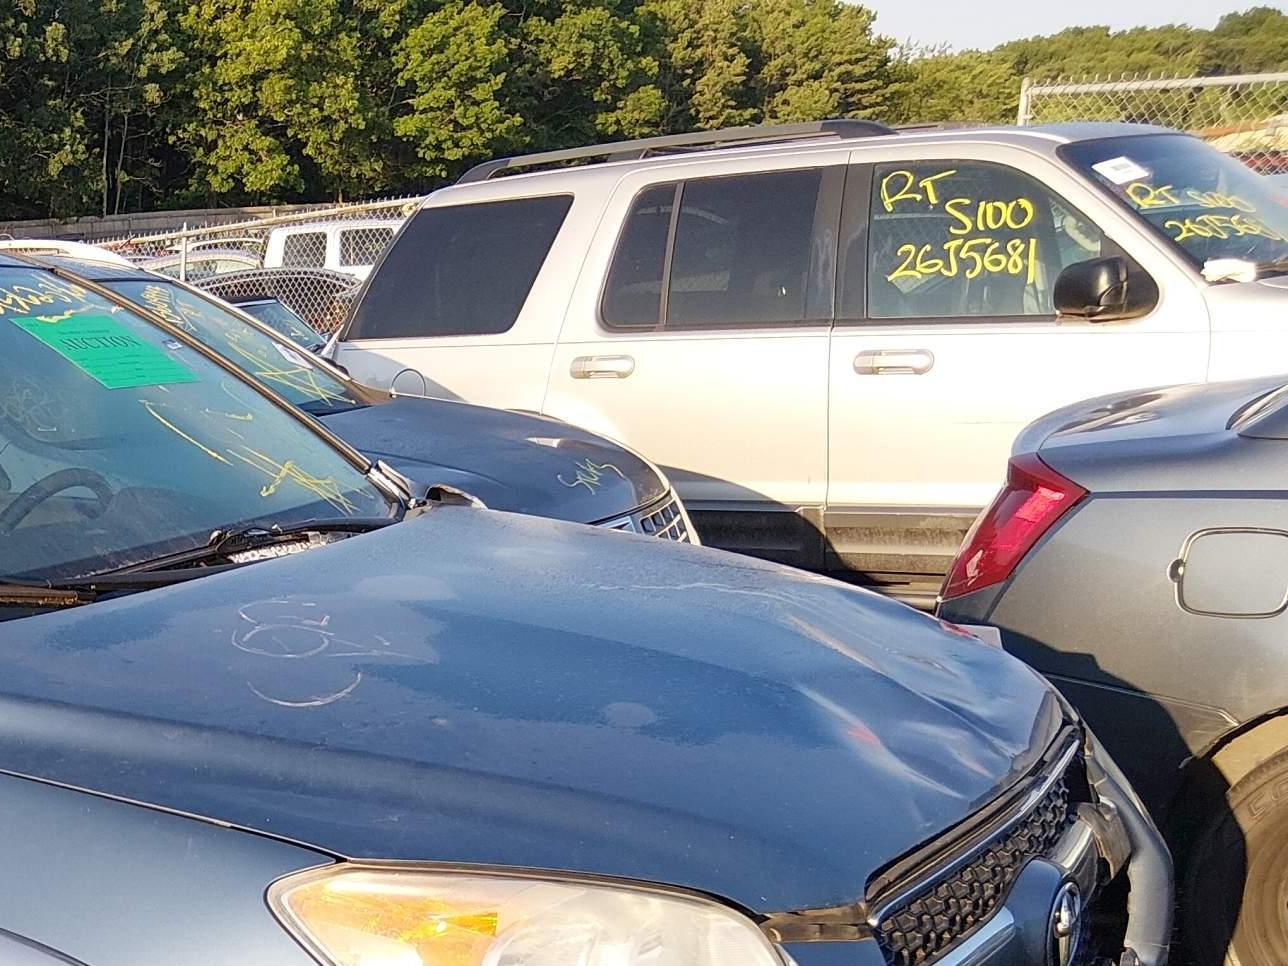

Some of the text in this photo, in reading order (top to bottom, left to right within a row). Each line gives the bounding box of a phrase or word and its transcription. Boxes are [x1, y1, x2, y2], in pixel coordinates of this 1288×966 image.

[880, 170, 957, 212] RT
[887, 238, 1037, 284] 26J5681
[62, 335, 141, 351] AUCTION
